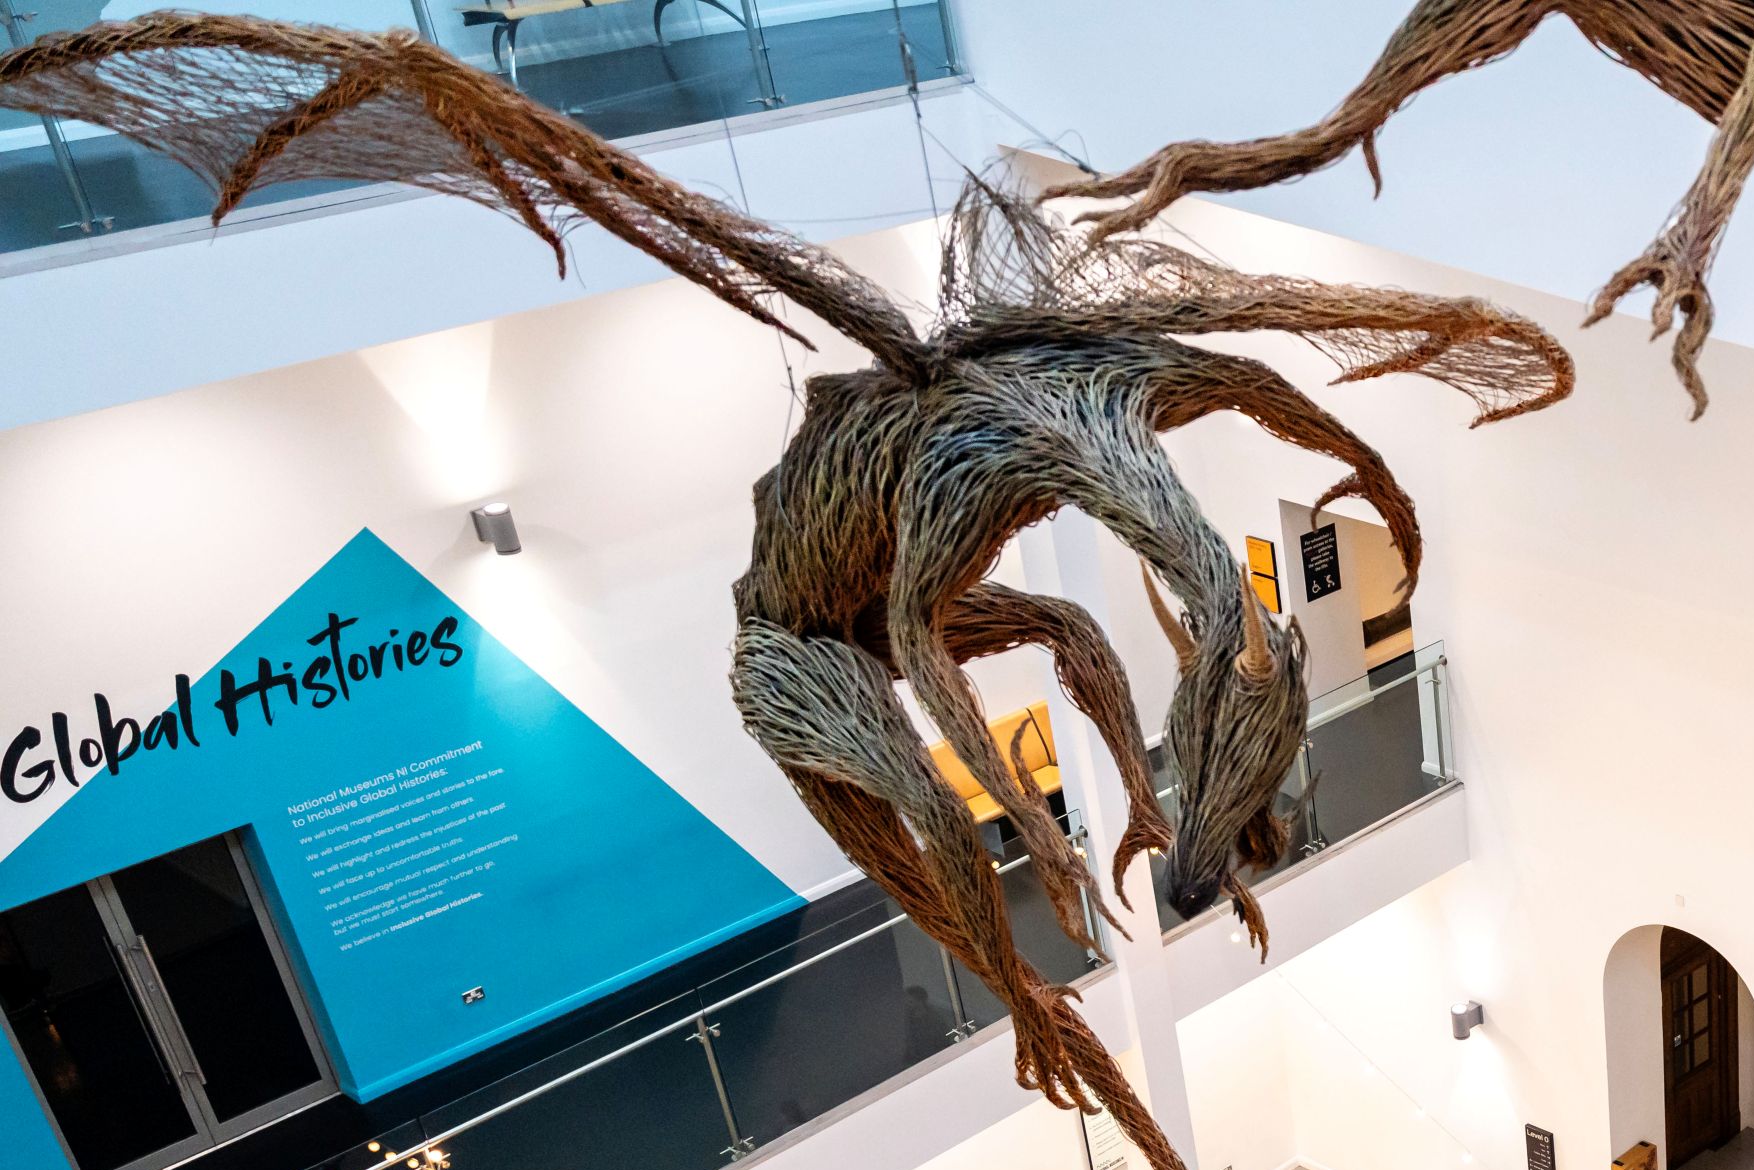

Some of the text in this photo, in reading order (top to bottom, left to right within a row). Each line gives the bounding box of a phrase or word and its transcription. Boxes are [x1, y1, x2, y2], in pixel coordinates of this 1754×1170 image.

[0, 613, 463, 804] Global Histories
[287, 740, 482, 815] National Museums NI Commitment
[292, 768, 448, 828] to Inclusive Global Histories:
[1527, 1128, 1543, 1141] Level
